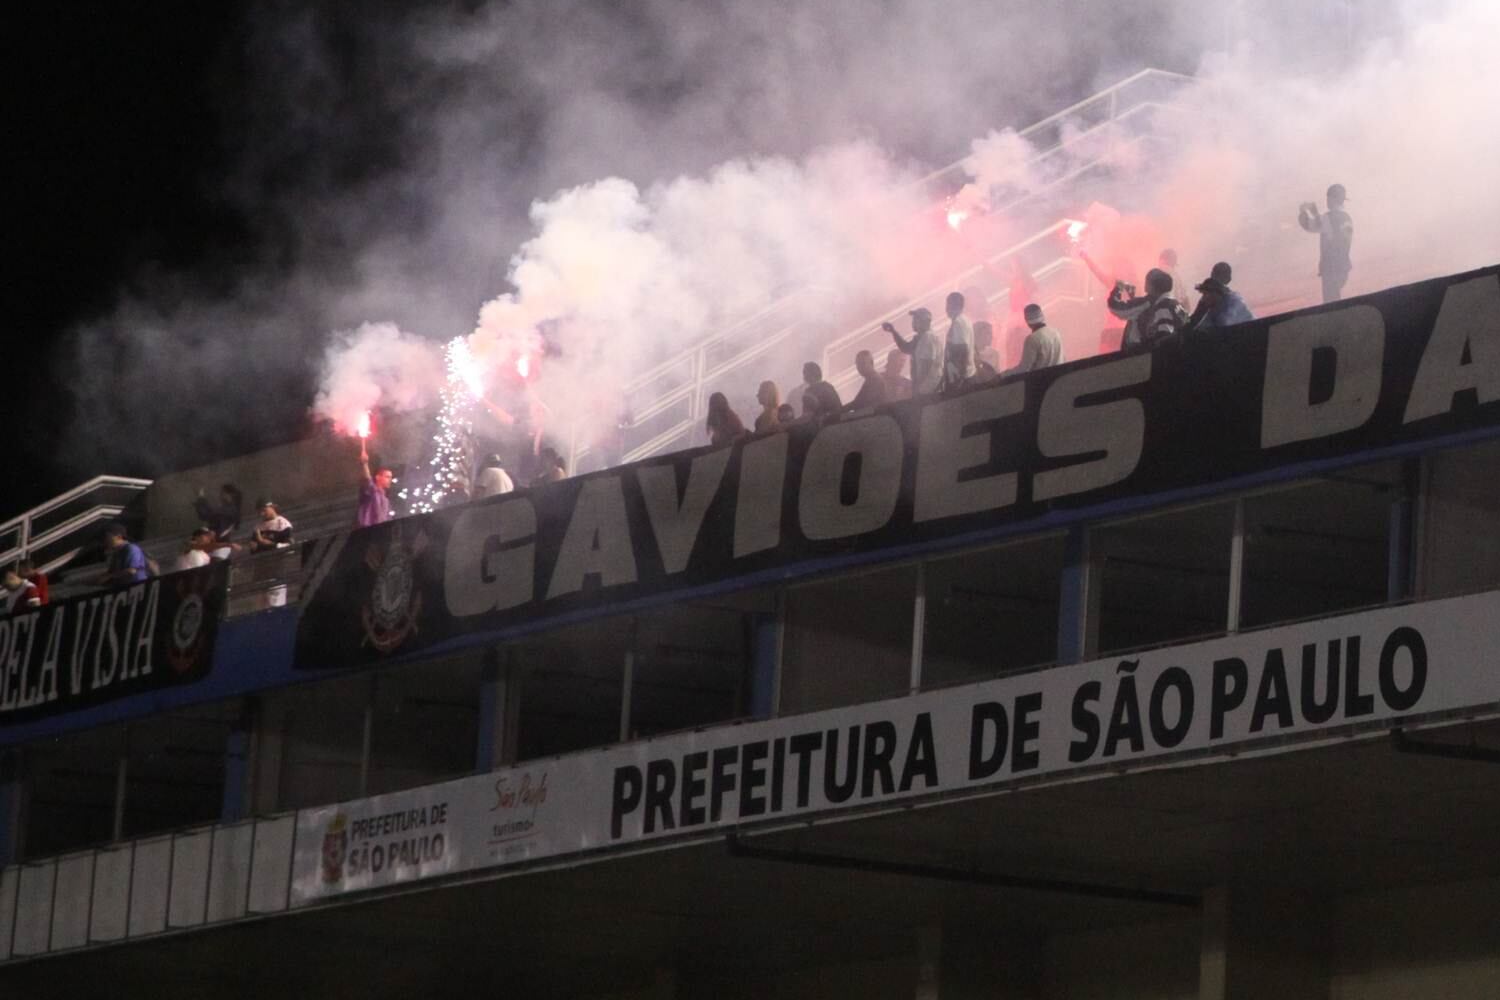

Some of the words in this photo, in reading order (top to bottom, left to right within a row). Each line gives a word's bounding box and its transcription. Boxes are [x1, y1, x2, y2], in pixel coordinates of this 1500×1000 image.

[71, 580, 160, 695] VISTA
[610, 711, 938, 840] PREFEITURA
[968, 691, 1044, 782] DE
[1067, 660, 1194, 763] SÃO
[1209, 626, 1428, 740] PAULO
[347, 840, 384, 877] SÃO
[387, 833, 445, 872] PAULO
[351, 806, 426, 841] PREFEITURA
[430, 803, 447, 824] DE
